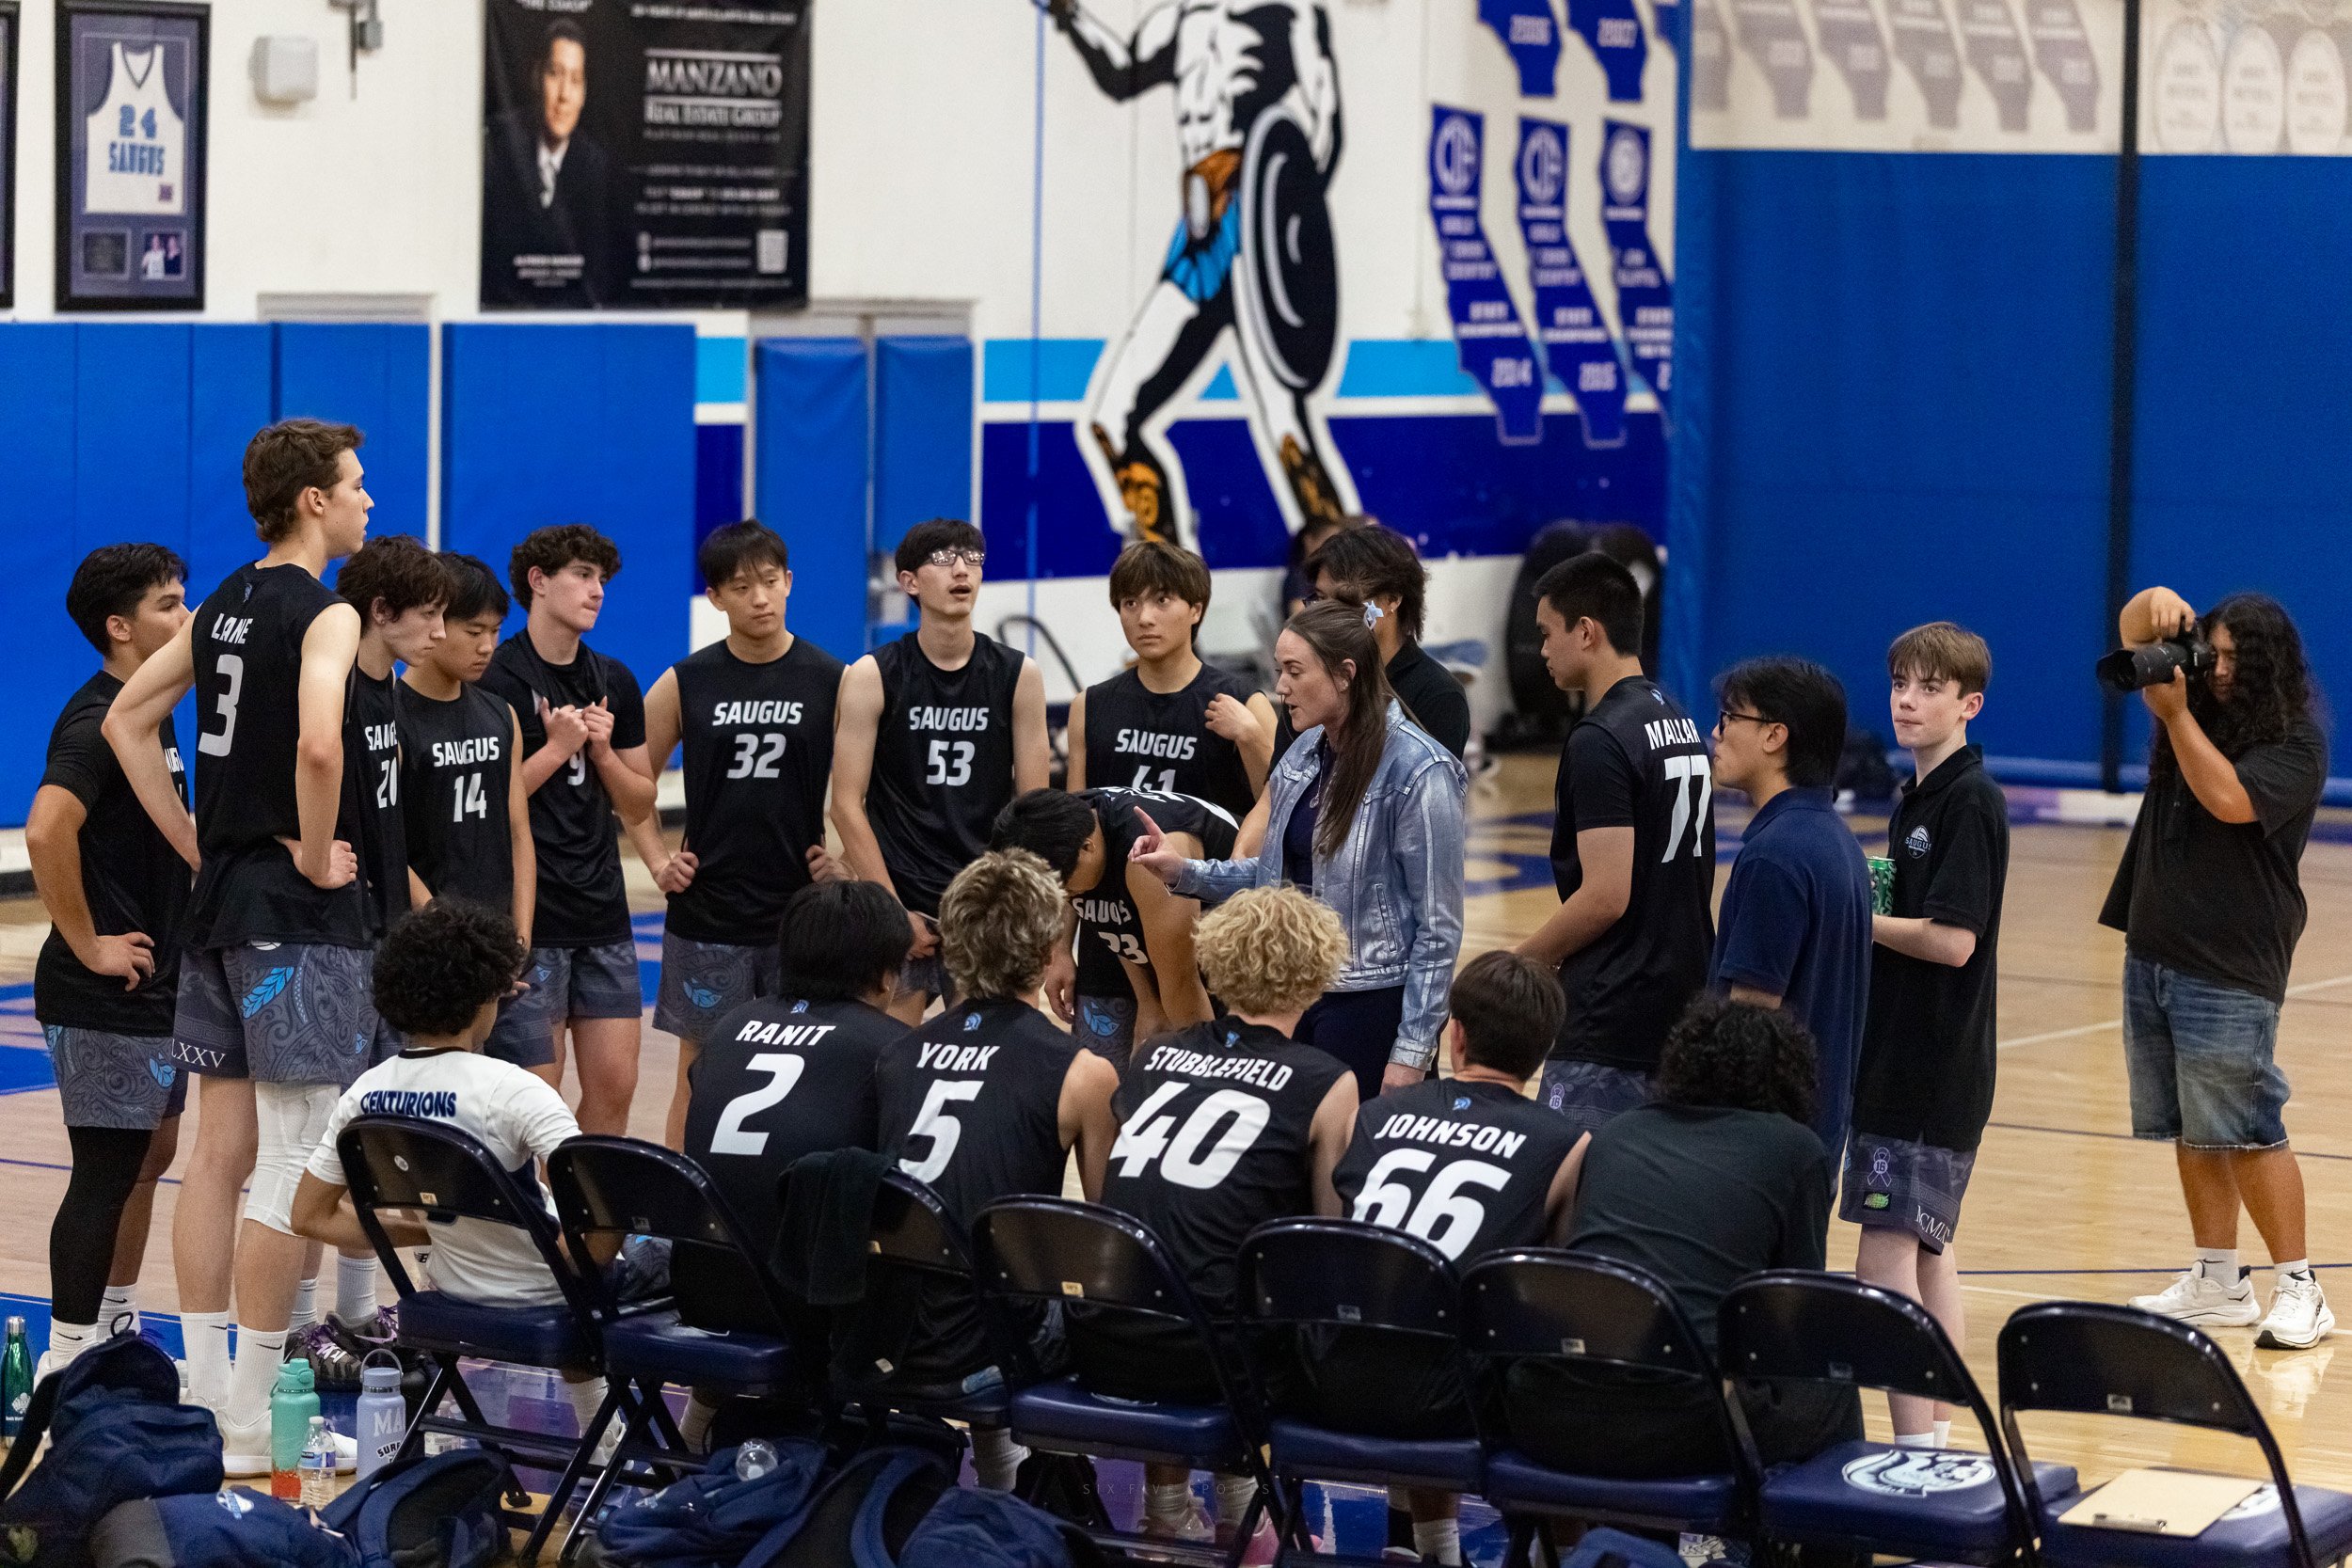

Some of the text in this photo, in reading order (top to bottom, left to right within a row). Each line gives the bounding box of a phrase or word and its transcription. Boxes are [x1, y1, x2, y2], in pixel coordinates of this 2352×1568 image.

[645, 60, 783, 96] MANZANO
[119, 104, 157, 139] 24
[211, 613, 253, 644] LANE
[198, 654, 244, 757] 3
[712, 701, 803, 726] SAUGUS
[909, 706, 989, 731] SAUGUS
[432, 736, 500, 768] SAUGUS
[726, 733, 787, 779] 32
[926, 739, 976, 786] 53
[1115, 728, 1198, 761] SAUGUS
[453, 772, 487, 823] 14
[1661, 754, 1712, 863] 77
[735, 1020, 836, 1046] RANIT
[916, 1042, 1000, 1070] YORK
[1143, 1045, 1294, 1091] STUBBLEFIELD
[359, 1090, 457, 1117] CENTURIONS
[709, 1053, 805, 1156] 2
[898, 1079, 985, 1184] 5
[1109, 1081, 1270, 1189] 40
[1374, 1114, 1527, 1159] JOHNSON
[1351, 1148, 1512, 1262] 66
